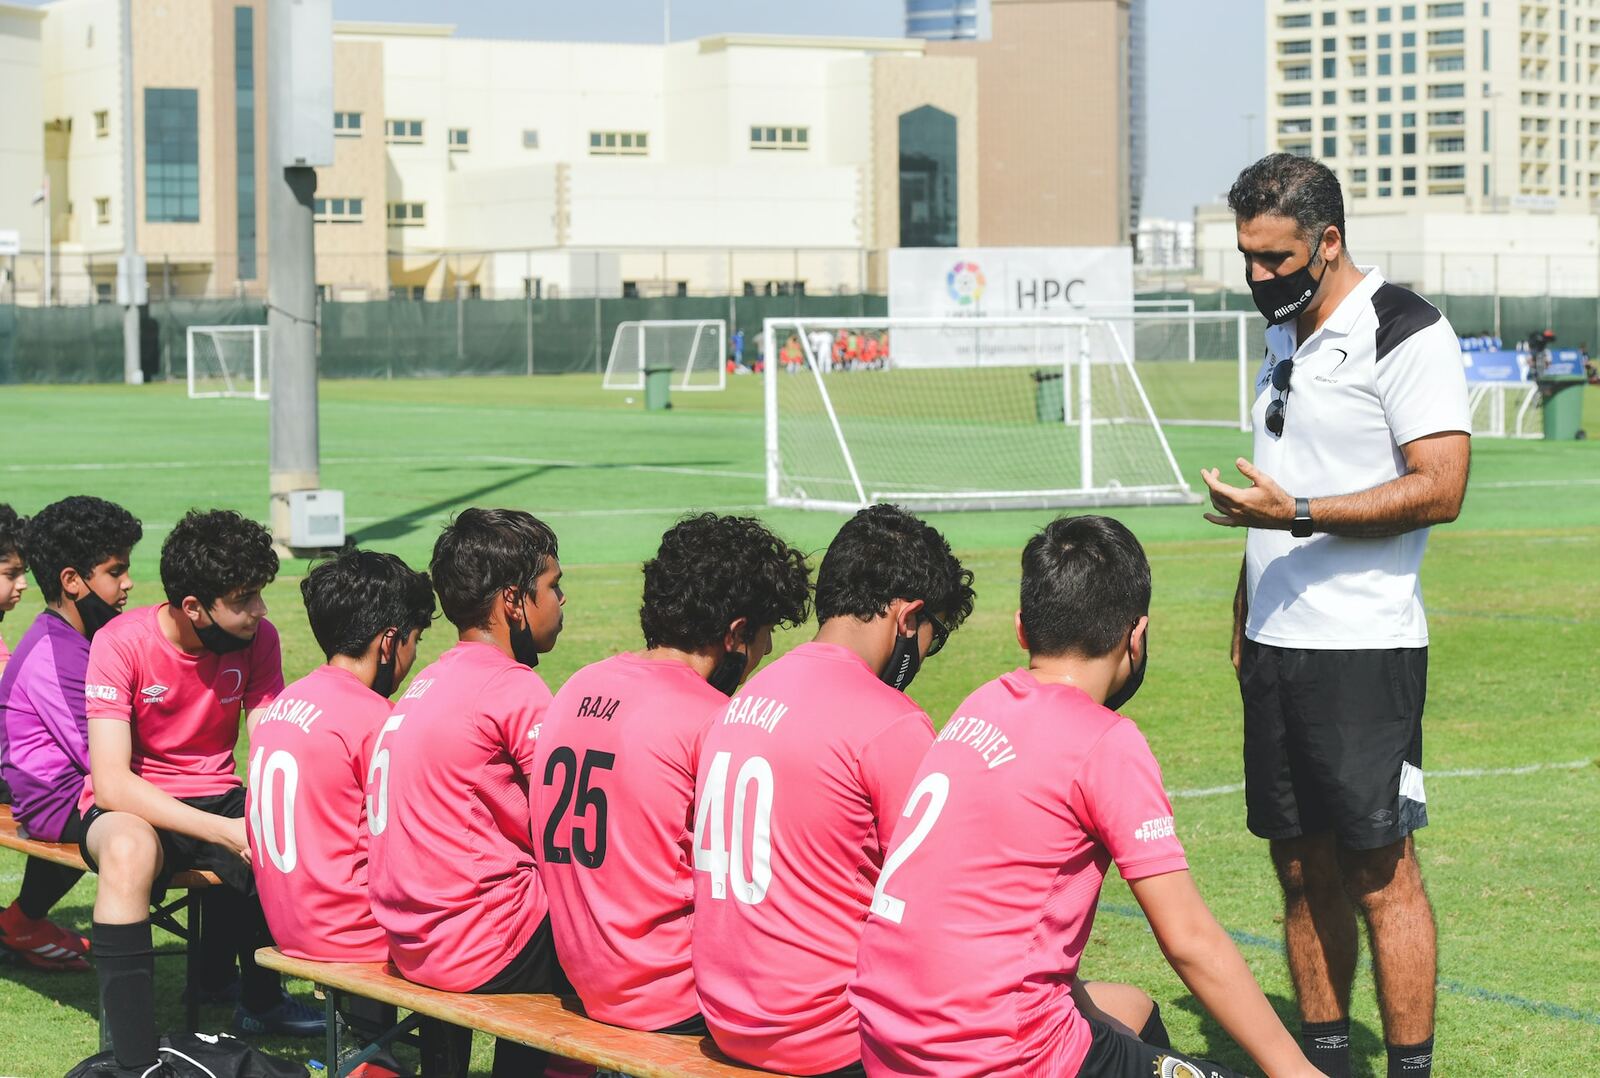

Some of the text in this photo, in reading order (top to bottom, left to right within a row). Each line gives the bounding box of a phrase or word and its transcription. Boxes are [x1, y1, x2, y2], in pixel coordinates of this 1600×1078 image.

[1017, 279, 1086, 310] HPC
[1274, 289, 1312, 319] Alliance
[577, 696, 620, 722] RAJA
[723, 696, 788, 733] RAKAN
[249, 745, 298, 874] 10
[543, 746, 616, 869] 25
[693, 751, 774, 905] 40
[869, 772, 950, 924] 2
